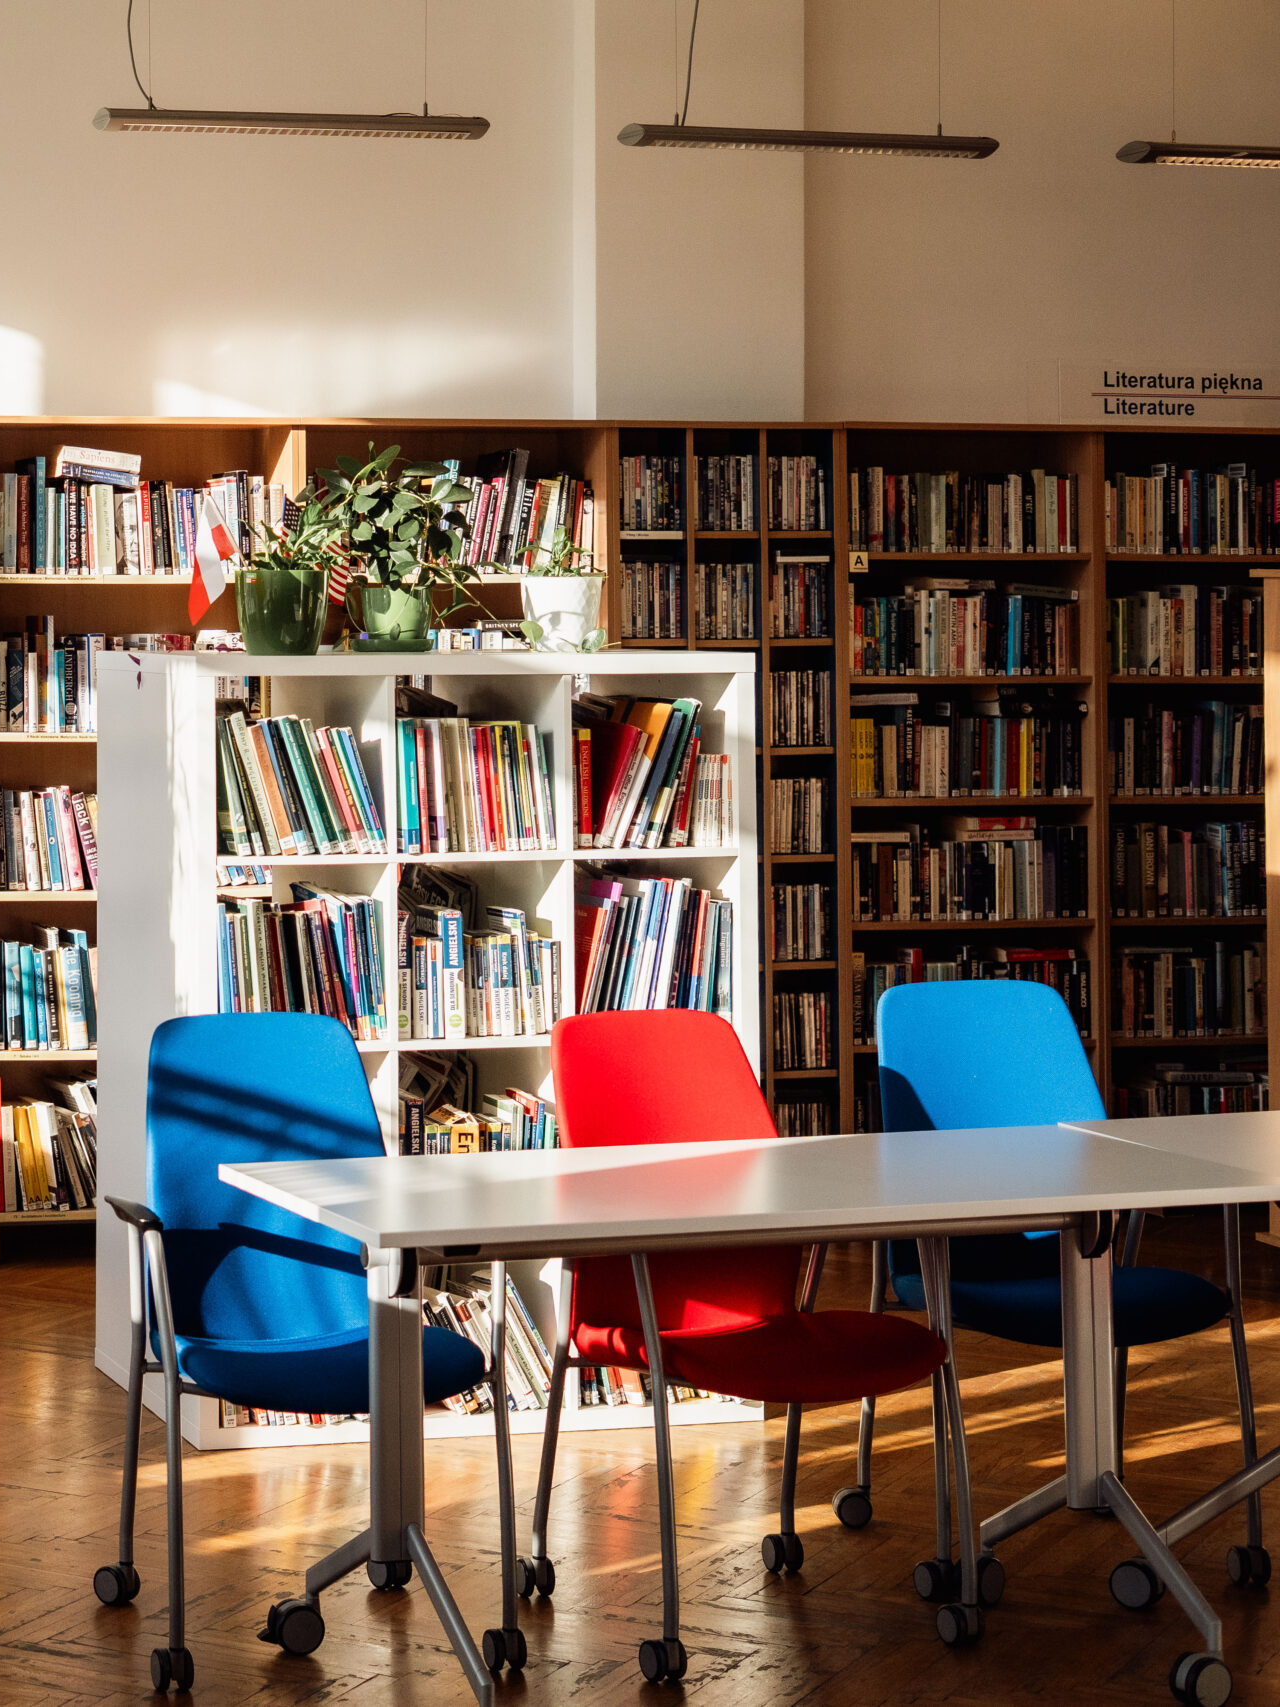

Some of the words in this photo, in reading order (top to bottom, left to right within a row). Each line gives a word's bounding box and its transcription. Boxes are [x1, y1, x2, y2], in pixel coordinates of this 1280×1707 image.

[1104, 371, 1195, 389] Literatura
[1201, 373, 1263, 394] piękna
[1104, 398, 1195, 416] Literature
[80, 449, 116, 464] Sapiens
[69, 491, 77, 503] WE
[521, 487, 535, 518] Miles
[69, 504, 77, 522] HAVE
[69, 526, 77, 540] NO
[69, 541, 77, 559] IDEA
[854, 555, 864, 567] A
[64, 647, 75, 701] LINDBERGH
[623, 774, 632, 790] Office
[616, 792, 626, 811] English
[1117, 832, 1125, 851] DAN
[1145, 832, 1154, 851] DAN
[1117, 852, 1125, 885] BROWN
[1145, 852, 1154, 885] BROWN
[398, 921, 407, 967] ANGIELSKI
[448, 920, 459, 966] ANGIELSKI
[65, 951, 76, 965] de
[68, 969, 84, 1018] Kooning
[410, 1107, 420, 1153] ANGIELSKI
